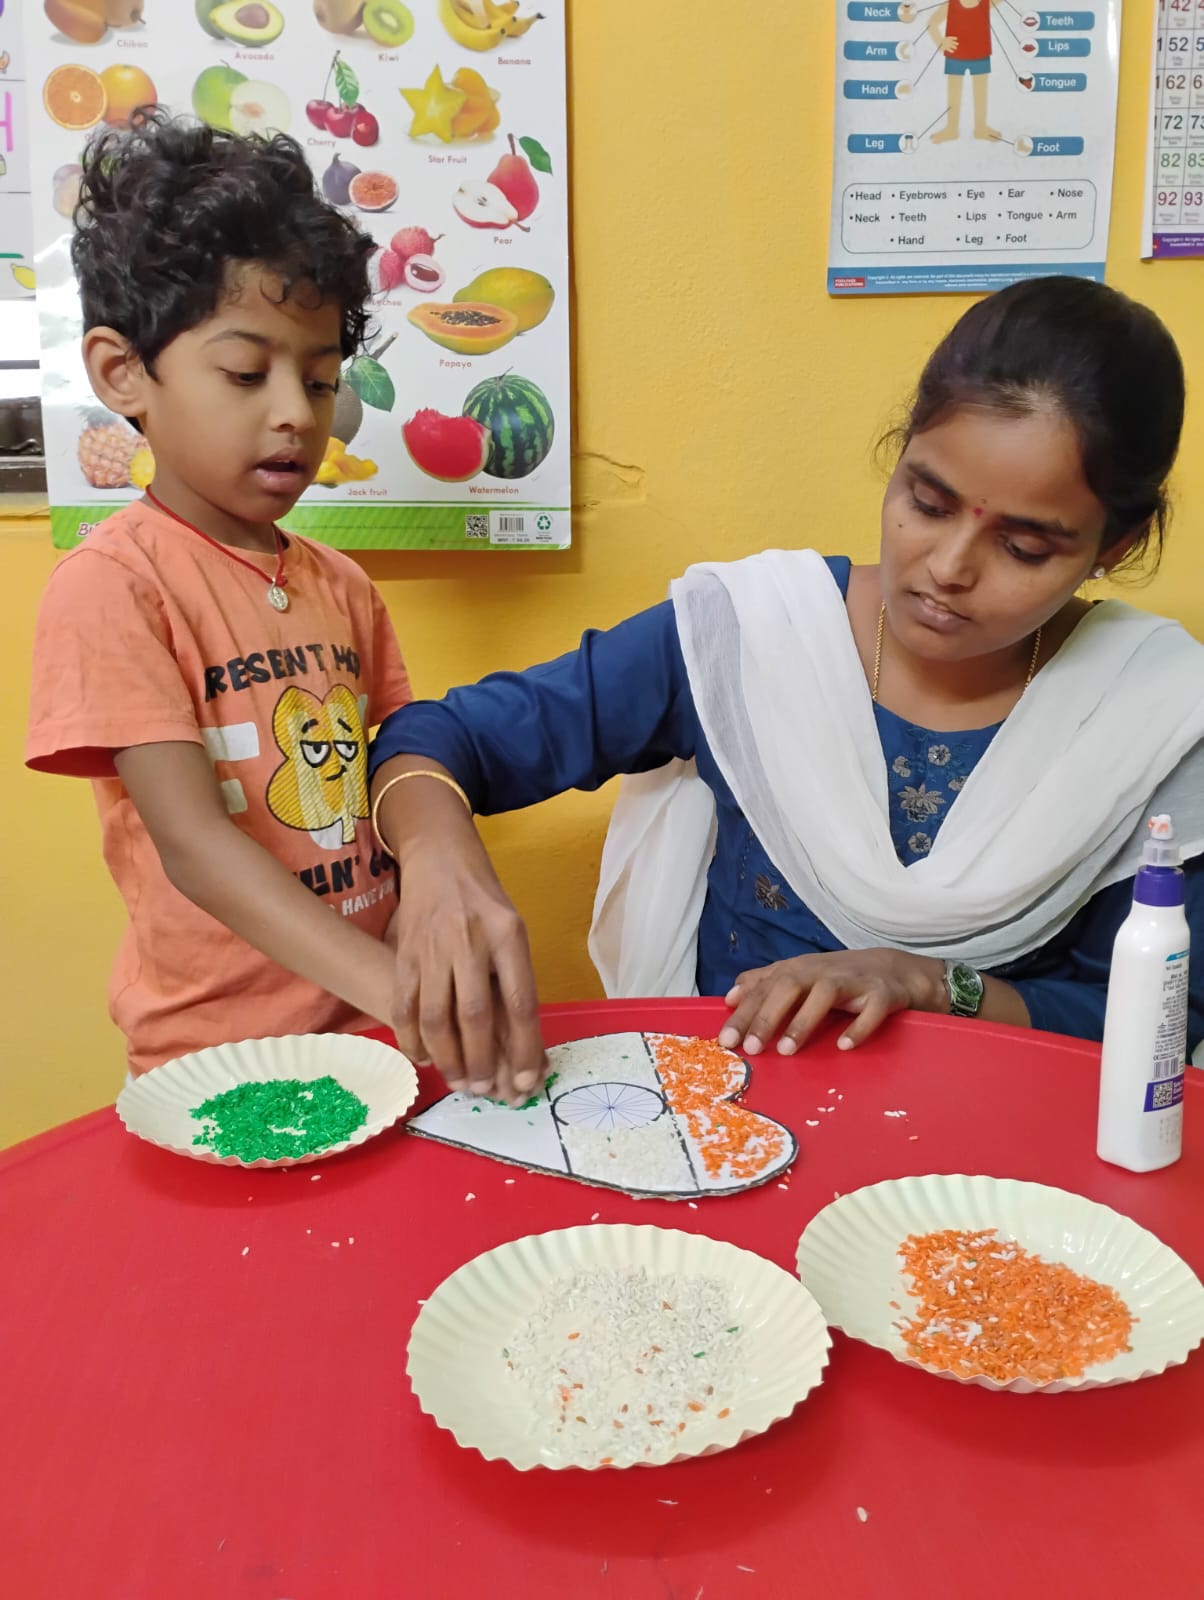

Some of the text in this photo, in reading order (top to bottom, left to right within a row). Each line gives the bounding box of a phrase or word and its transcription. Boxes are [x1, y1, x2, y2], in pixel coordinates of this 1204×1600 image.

[1170, 0, 1191, 11] 42
[864, 7, 891, 17] Neck
[1045, 15, 1074, 26] Teeth
[1048, 41, 1070, 51] Lips
[1168, 37, 1189, 51] 52
[234, 51, 274, 61] Avocado
[865, 46, 888, 56] Arm
[378, 53, 400, 62] Kiwi
[497, 57, 532, 65] Banana
[1039, 77, 1077, 88] Tongue
[1165, 74, 1186, 89] 62
[861, 85, 889, 95] Hand
[1164, 115, 1183, 130] 72
[307, 137, 336, 148] Cherry
[865, 138, 885, 149] Leg
[1036, 143, 1060, 152] Foot
[428, 155, 467, 164] Star Fruit
[1161, 153, 1181, 168] 82
[855, 188, 1084, 202] Head Eyebrows Eye Ear Nose
[1158, 191, 1177, 206] 92
[1184, 191, 1203, 206] 93
[854, 210, 1077, 223] Neck Teeth Lips Tongue Arm
[493, 236, 513, 245] Pear
[898, 233, 1027, 245] Hand Leg Foot
[439, 359, 472, 369] Papaya
[347, 488, 388, 496] Jack fruit
[469, 486, 520, 495] Watermelon
